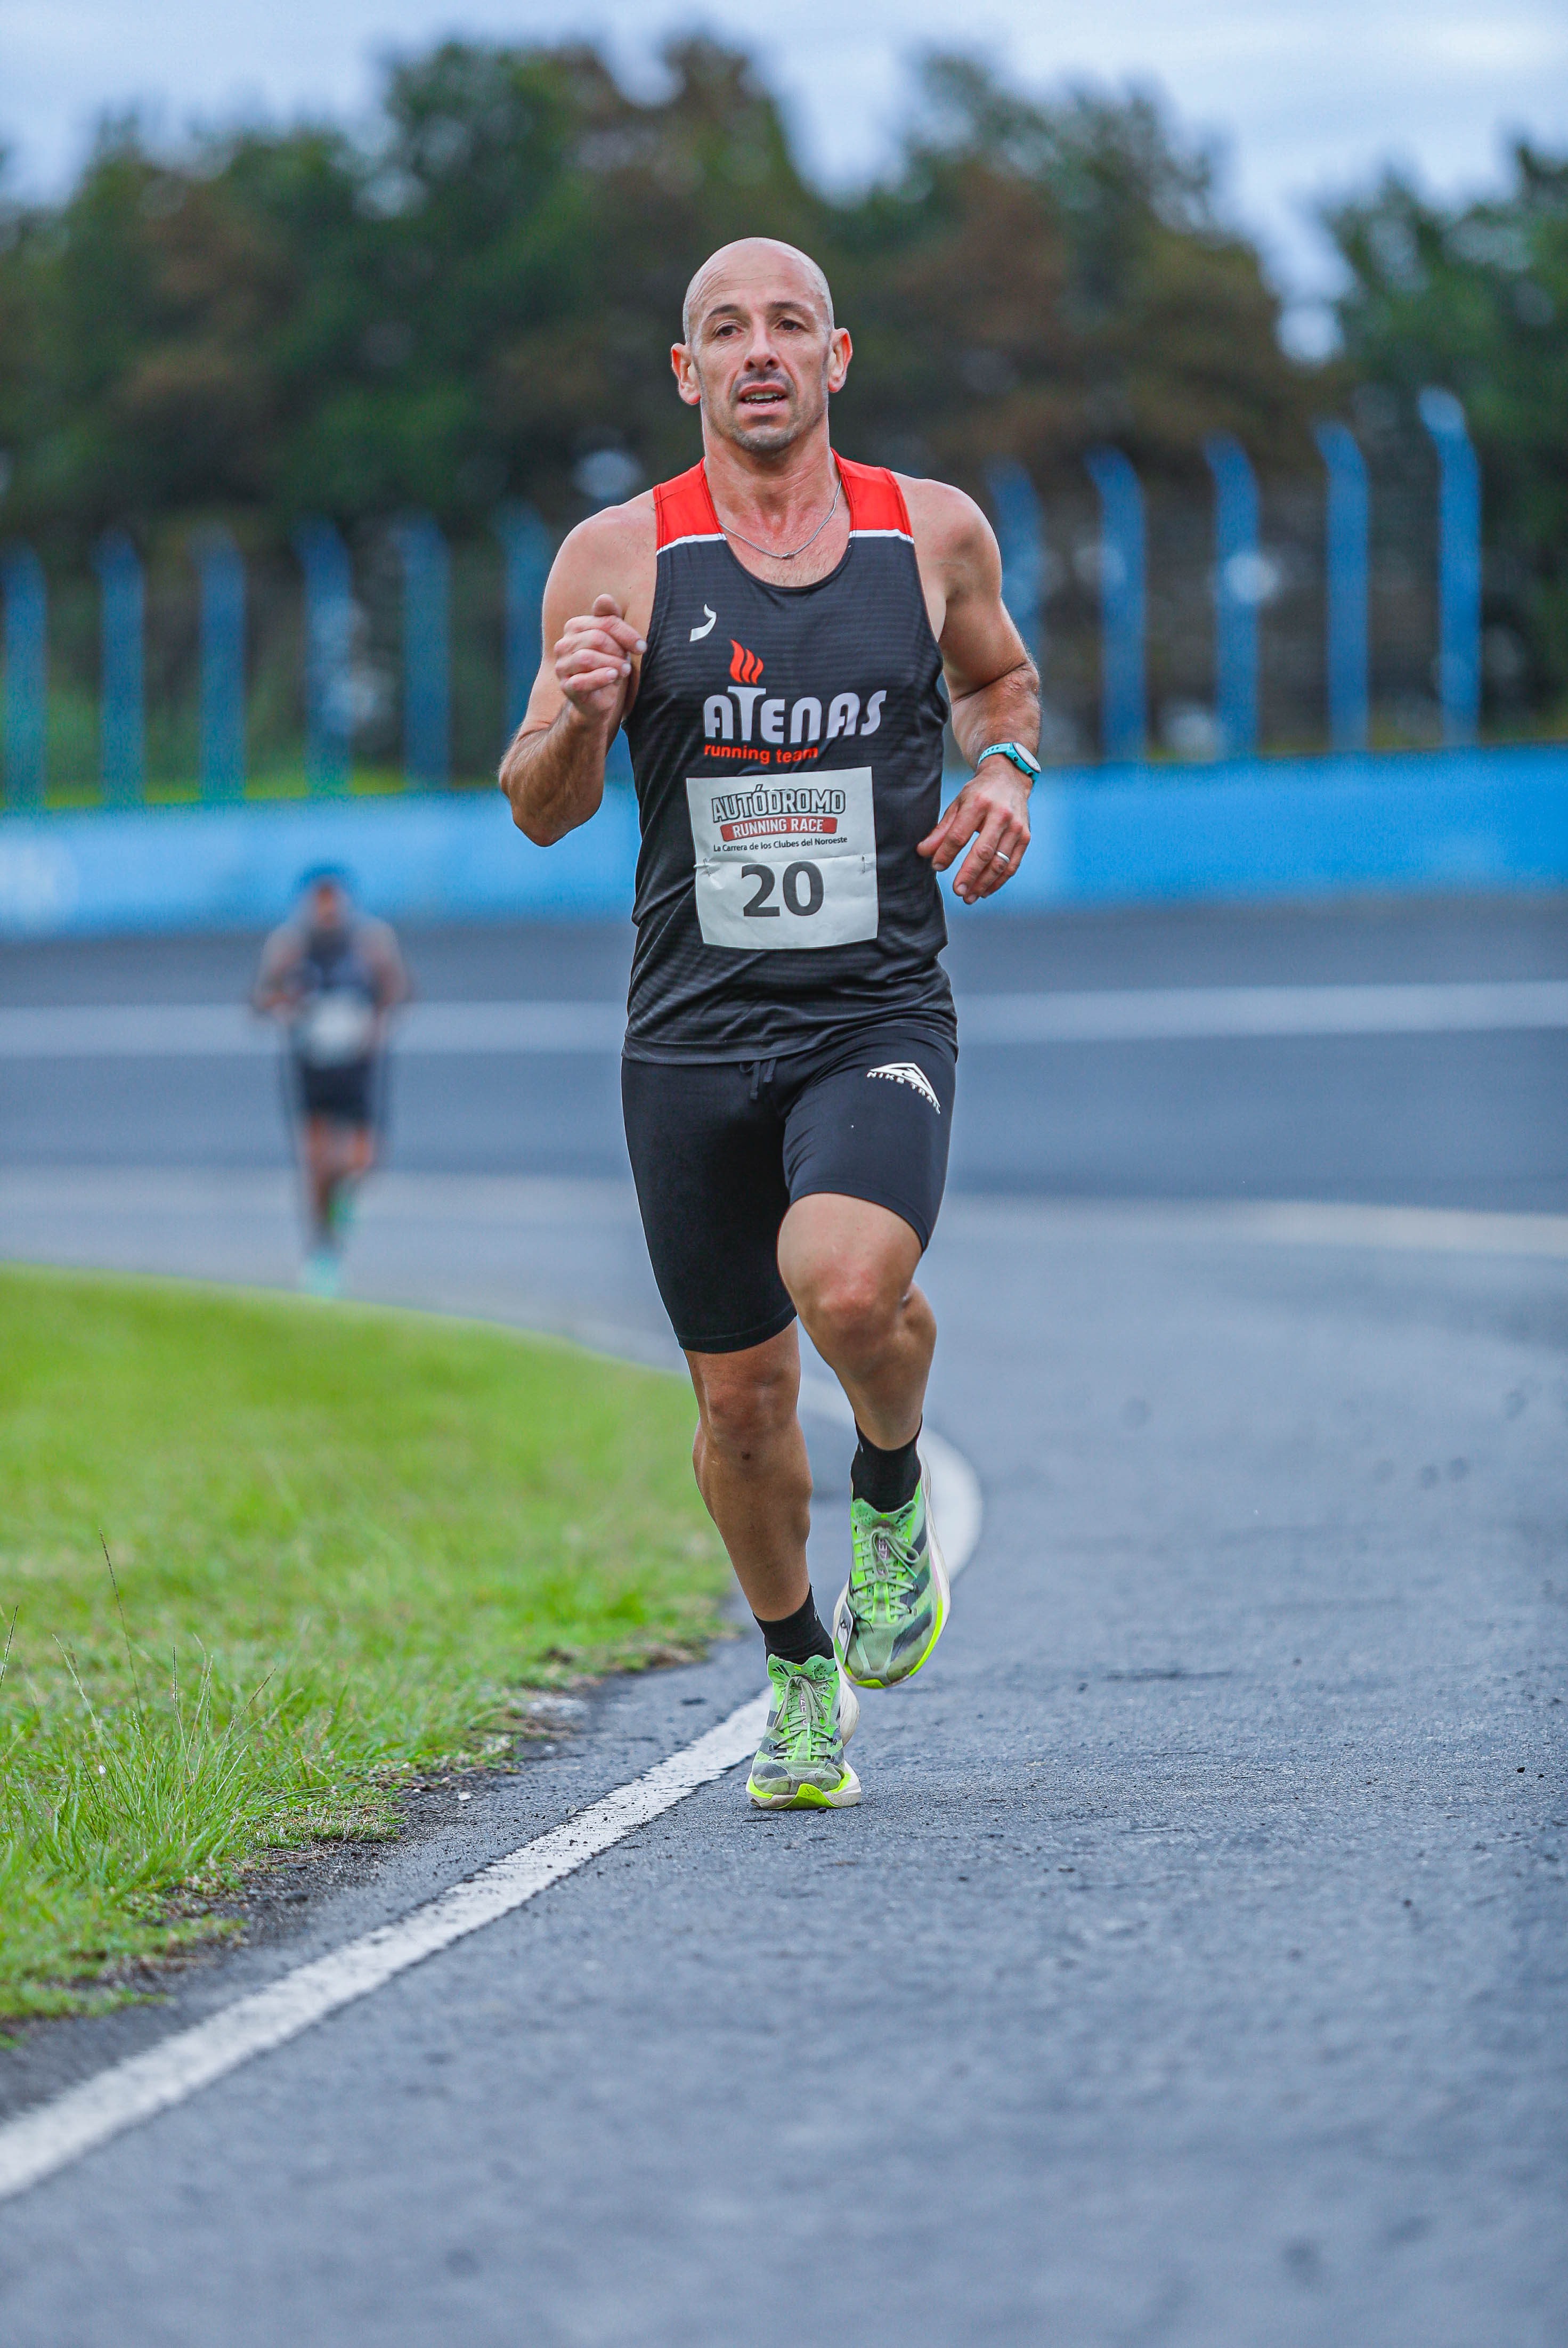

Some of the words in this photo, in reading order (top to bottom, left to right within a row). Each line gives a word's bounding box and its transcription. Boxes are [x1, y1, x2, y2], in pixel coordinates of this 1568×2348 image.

[703, 685, 887, 744] ATENAS
[704, 744, 770, 765] running
[776, 746, 818, 763] team
[711, 784, 846, 823] AUTÓDROMO
[732, 818, 787, 839] RUNNING
[791, 818, 824, 832] RACE
[749, 842, 759, 850] de
[761, 841, 772, 849] los
[774, 840, 799, 848] Clubes
[801, 838, 813, 847] del
[815, 836, 848, 846] Noroeste
[741, 860, 824, 917] 20
